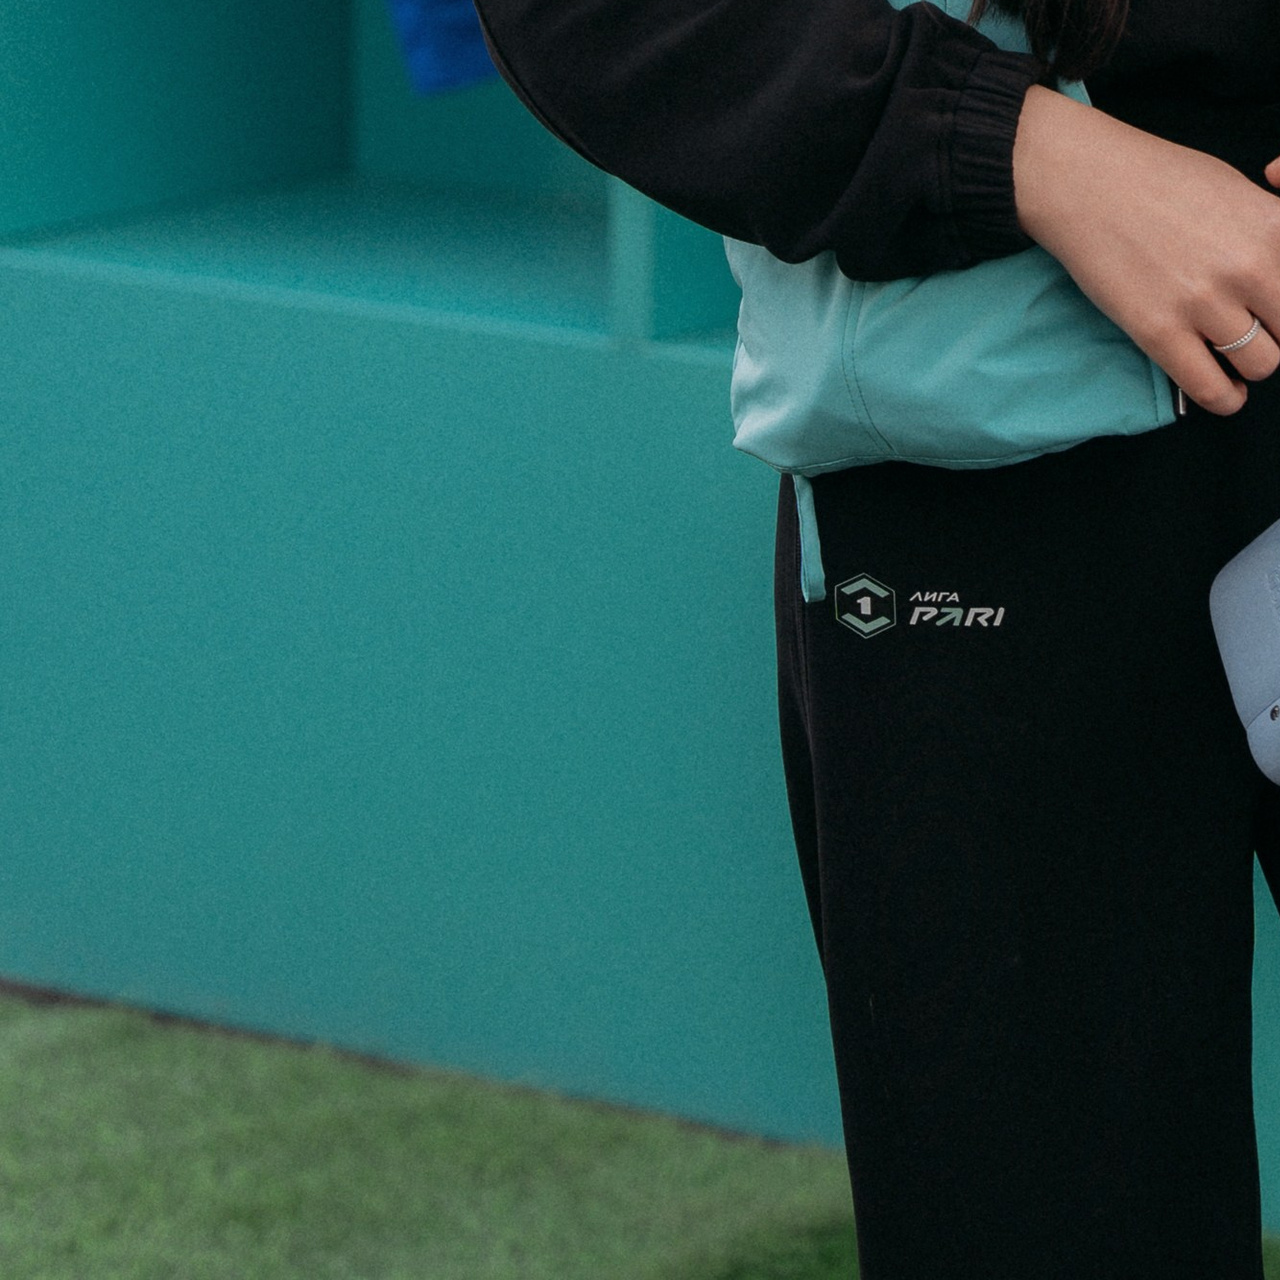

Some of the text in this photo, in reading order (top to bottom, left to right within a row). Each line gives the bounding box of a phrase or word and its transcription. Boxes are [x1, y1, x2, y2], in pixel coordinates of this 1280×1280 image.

[856, 596, 872, 615] 1
[909, 591, 960, 603] ЛИГА
[909, 606, 1006, 627] PARI
